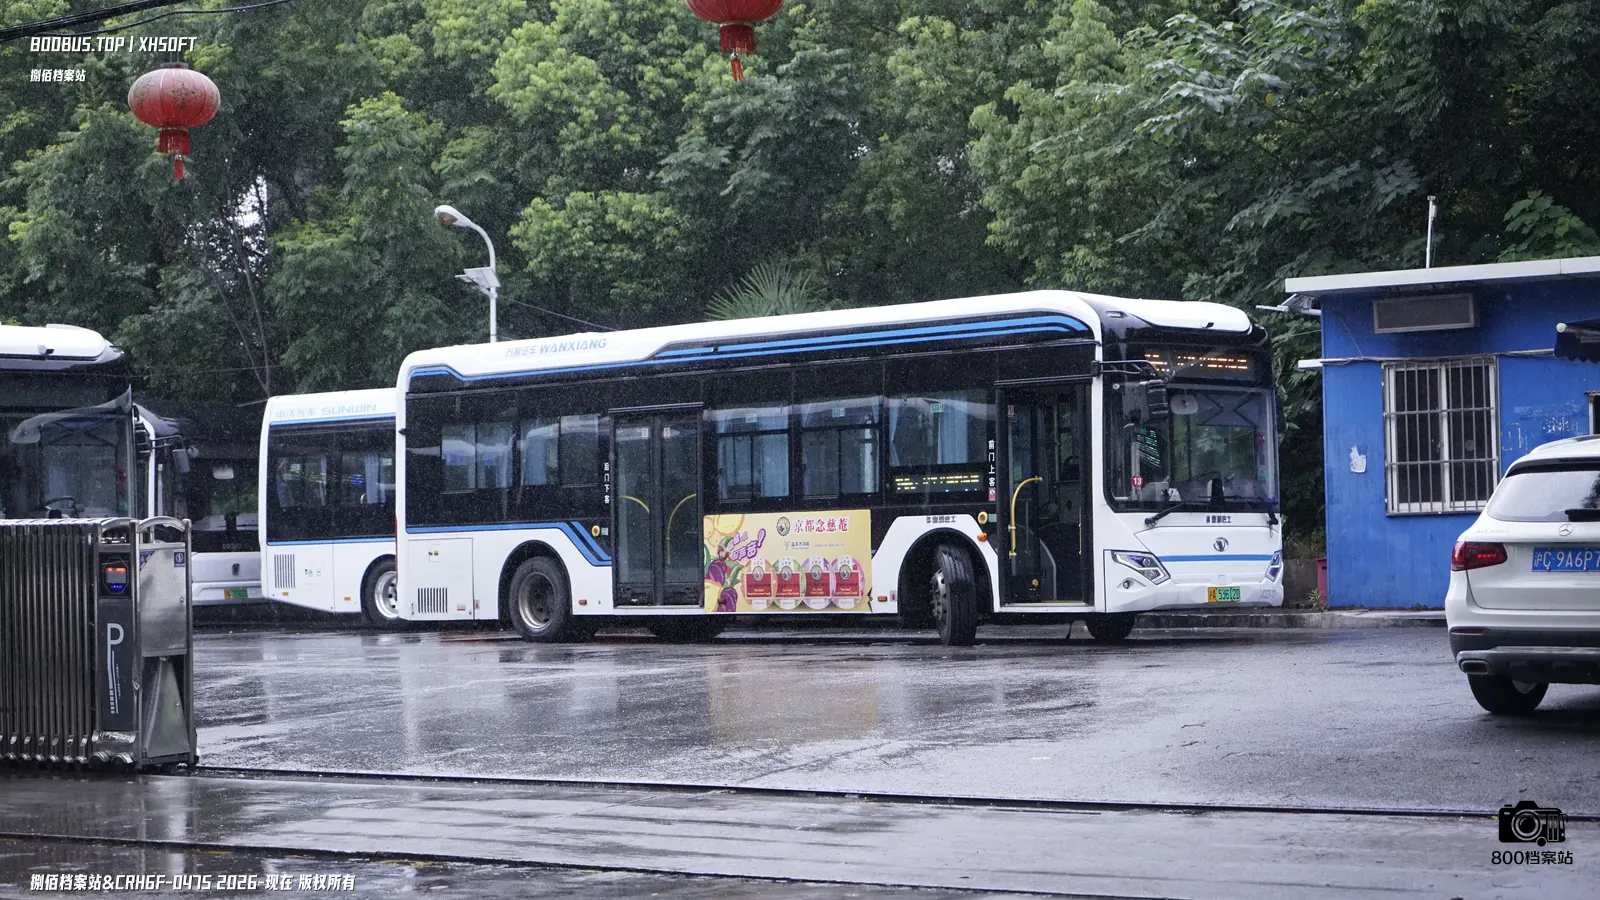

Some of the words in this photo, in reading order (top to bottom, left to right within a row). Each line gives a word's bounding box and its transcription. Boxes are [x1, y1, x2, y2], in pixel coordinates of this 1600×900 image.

[540, 338, 608, 354] WANXIANG
[321, 403, 378, 416] SUNWIN
[1133, 477, 1142, 486] 13
